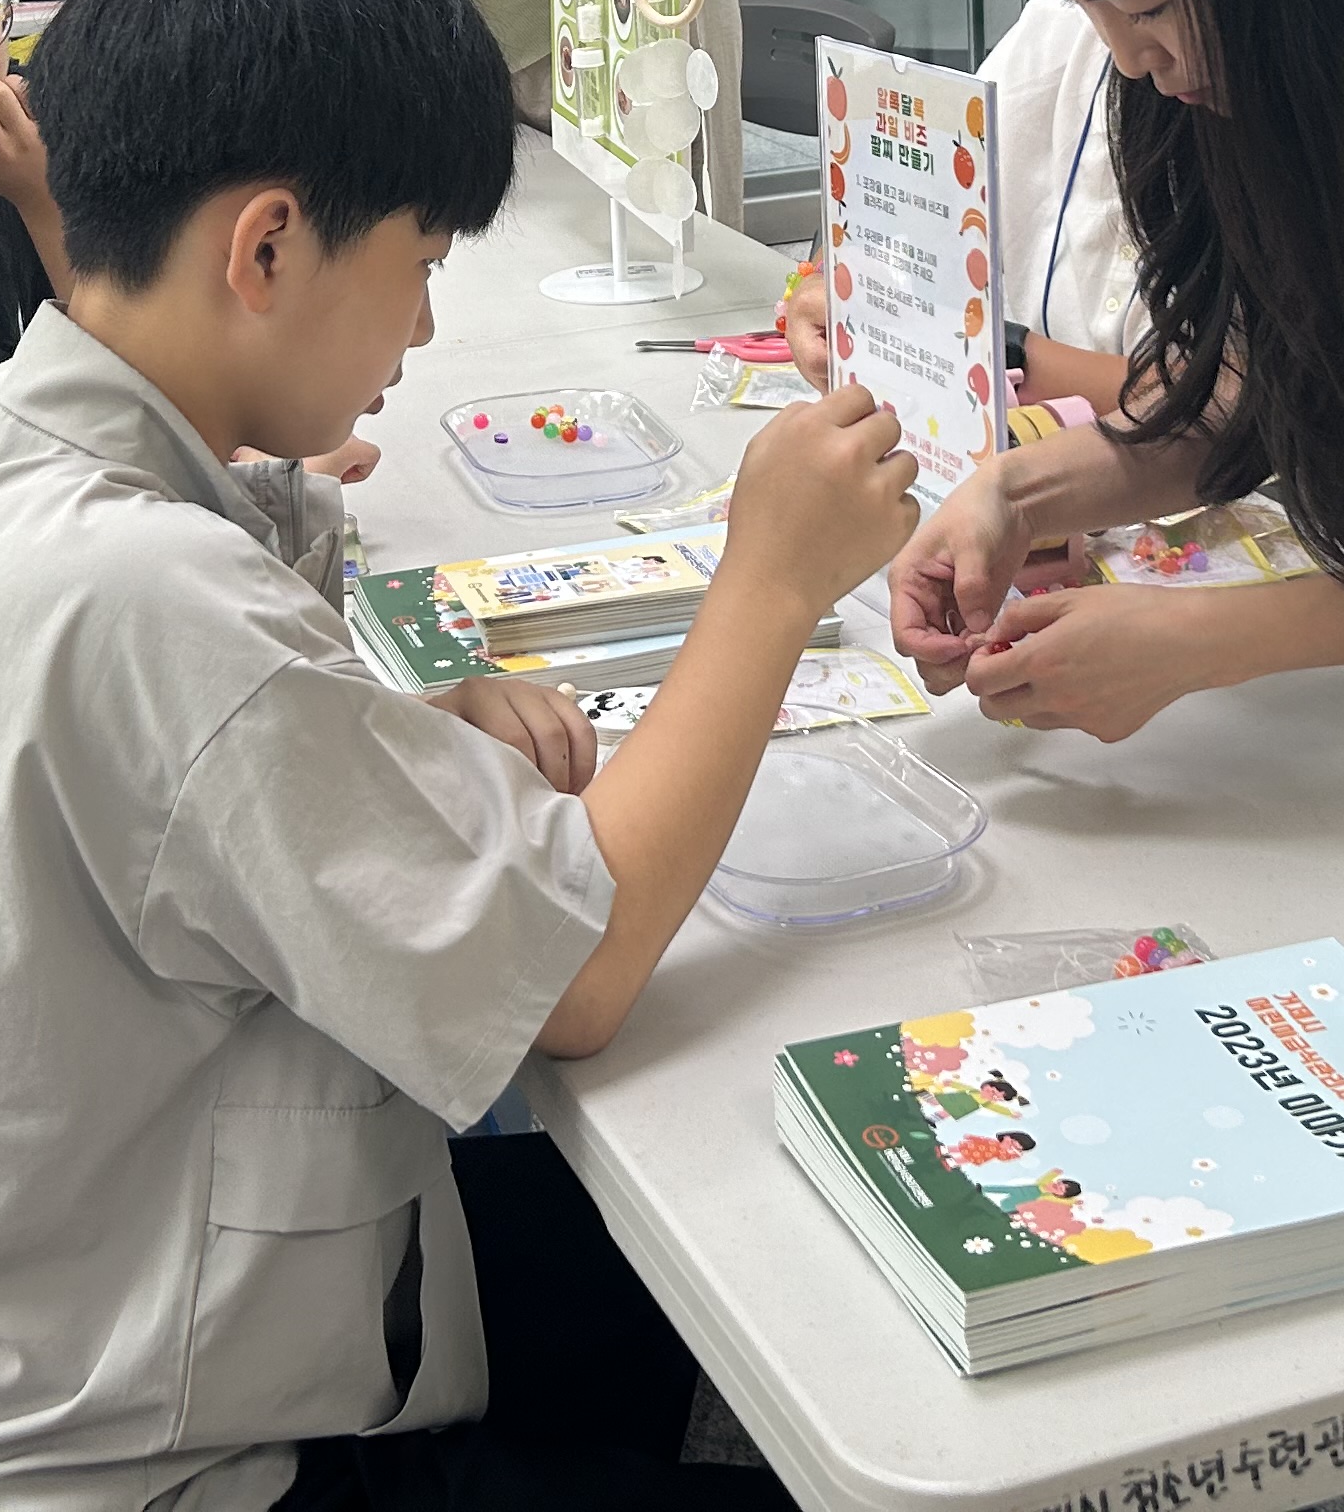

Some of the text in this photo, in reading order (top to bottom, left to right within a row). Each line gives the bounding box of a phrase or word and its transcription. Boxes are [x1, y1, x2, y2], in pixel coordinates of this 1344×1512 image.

[877, 87, 925, 121] 알록달록
[875, 111, 928, 148] 과일 비즈
[870, 134, 935, 176] 팔찌 만들기
[1272, 990, 1328, 1033] 거제시
[1193, 1003, 1305, 1092] 2023년
